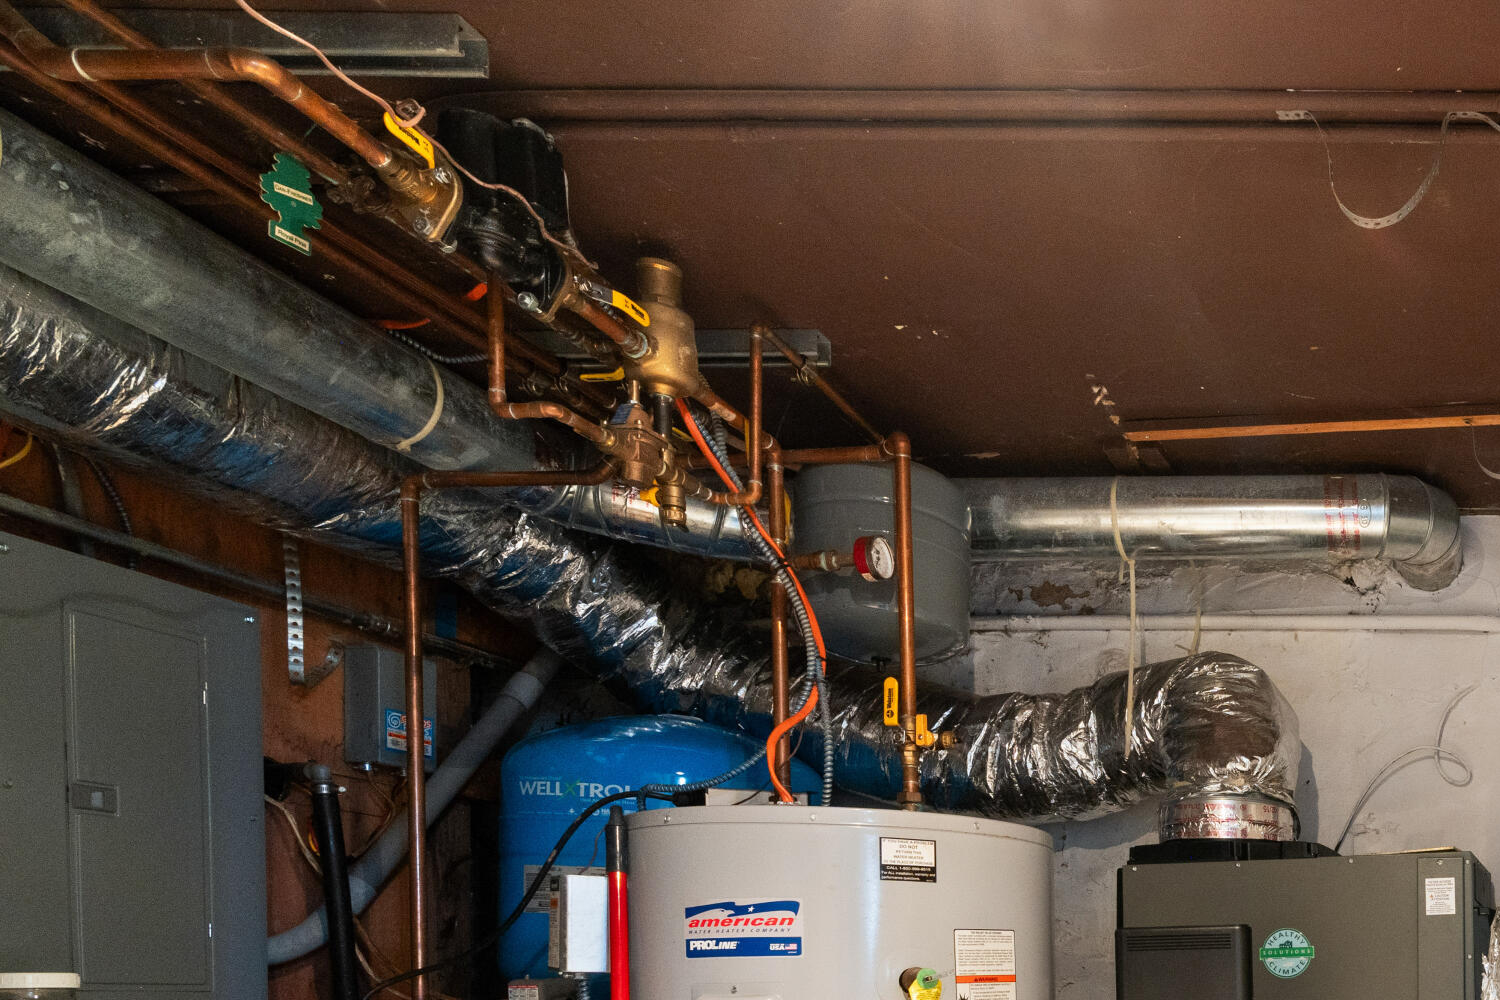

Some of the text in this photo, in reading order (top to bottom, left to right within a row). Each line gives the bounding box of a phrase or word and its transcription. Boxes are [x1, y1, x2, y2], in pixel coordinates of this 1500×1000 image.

[688, 917, 794, 928] american
[1267, 931, 1305, 947] HEALTHY
[1263, 948, 1311, 956] SOLUTIONS
[1269, 959, 1305, 975] CLIMATE
